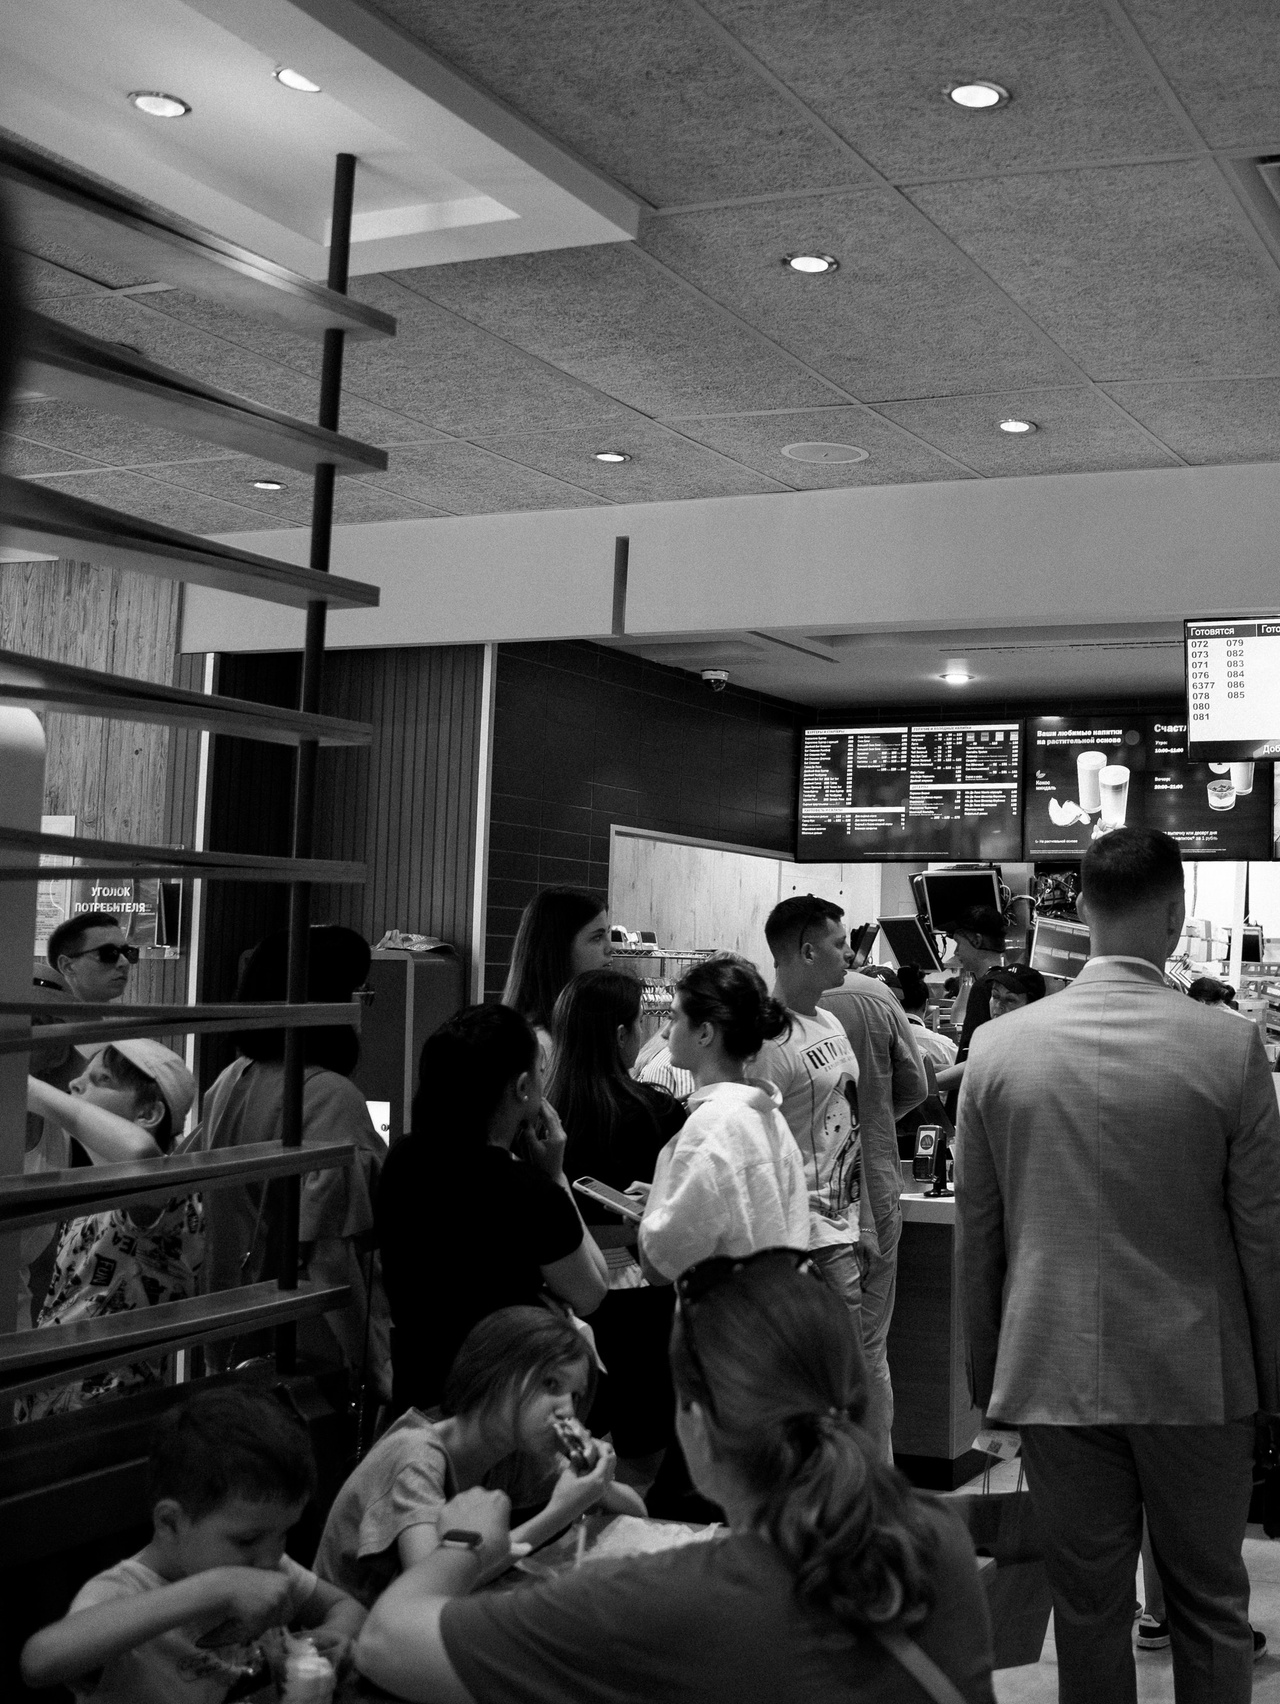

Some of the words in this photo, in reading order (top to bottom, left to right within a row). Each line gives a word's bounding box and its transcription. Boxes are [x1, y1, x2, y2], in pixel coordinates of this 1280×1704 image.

[1190, 627, 1235, 636] Готовятся
[1226, 639, 1244, 647] 079
[1227, 660, 1244, 668] 083
[1192, 682, 1215, 690] 6377
[1192, 692, 1209, 700] 078
[1193, 713, 1209, 721] 081
[1057, 729, 1092, 737] любимые
[1047, 737, 1095, 746] растительной
[91, 886, 131, 897] УГОЛОК
[75, 902, 146, 913] ПОТРЕБИТЕЛЯ
[806, 1046, 830, 1070] FLY
